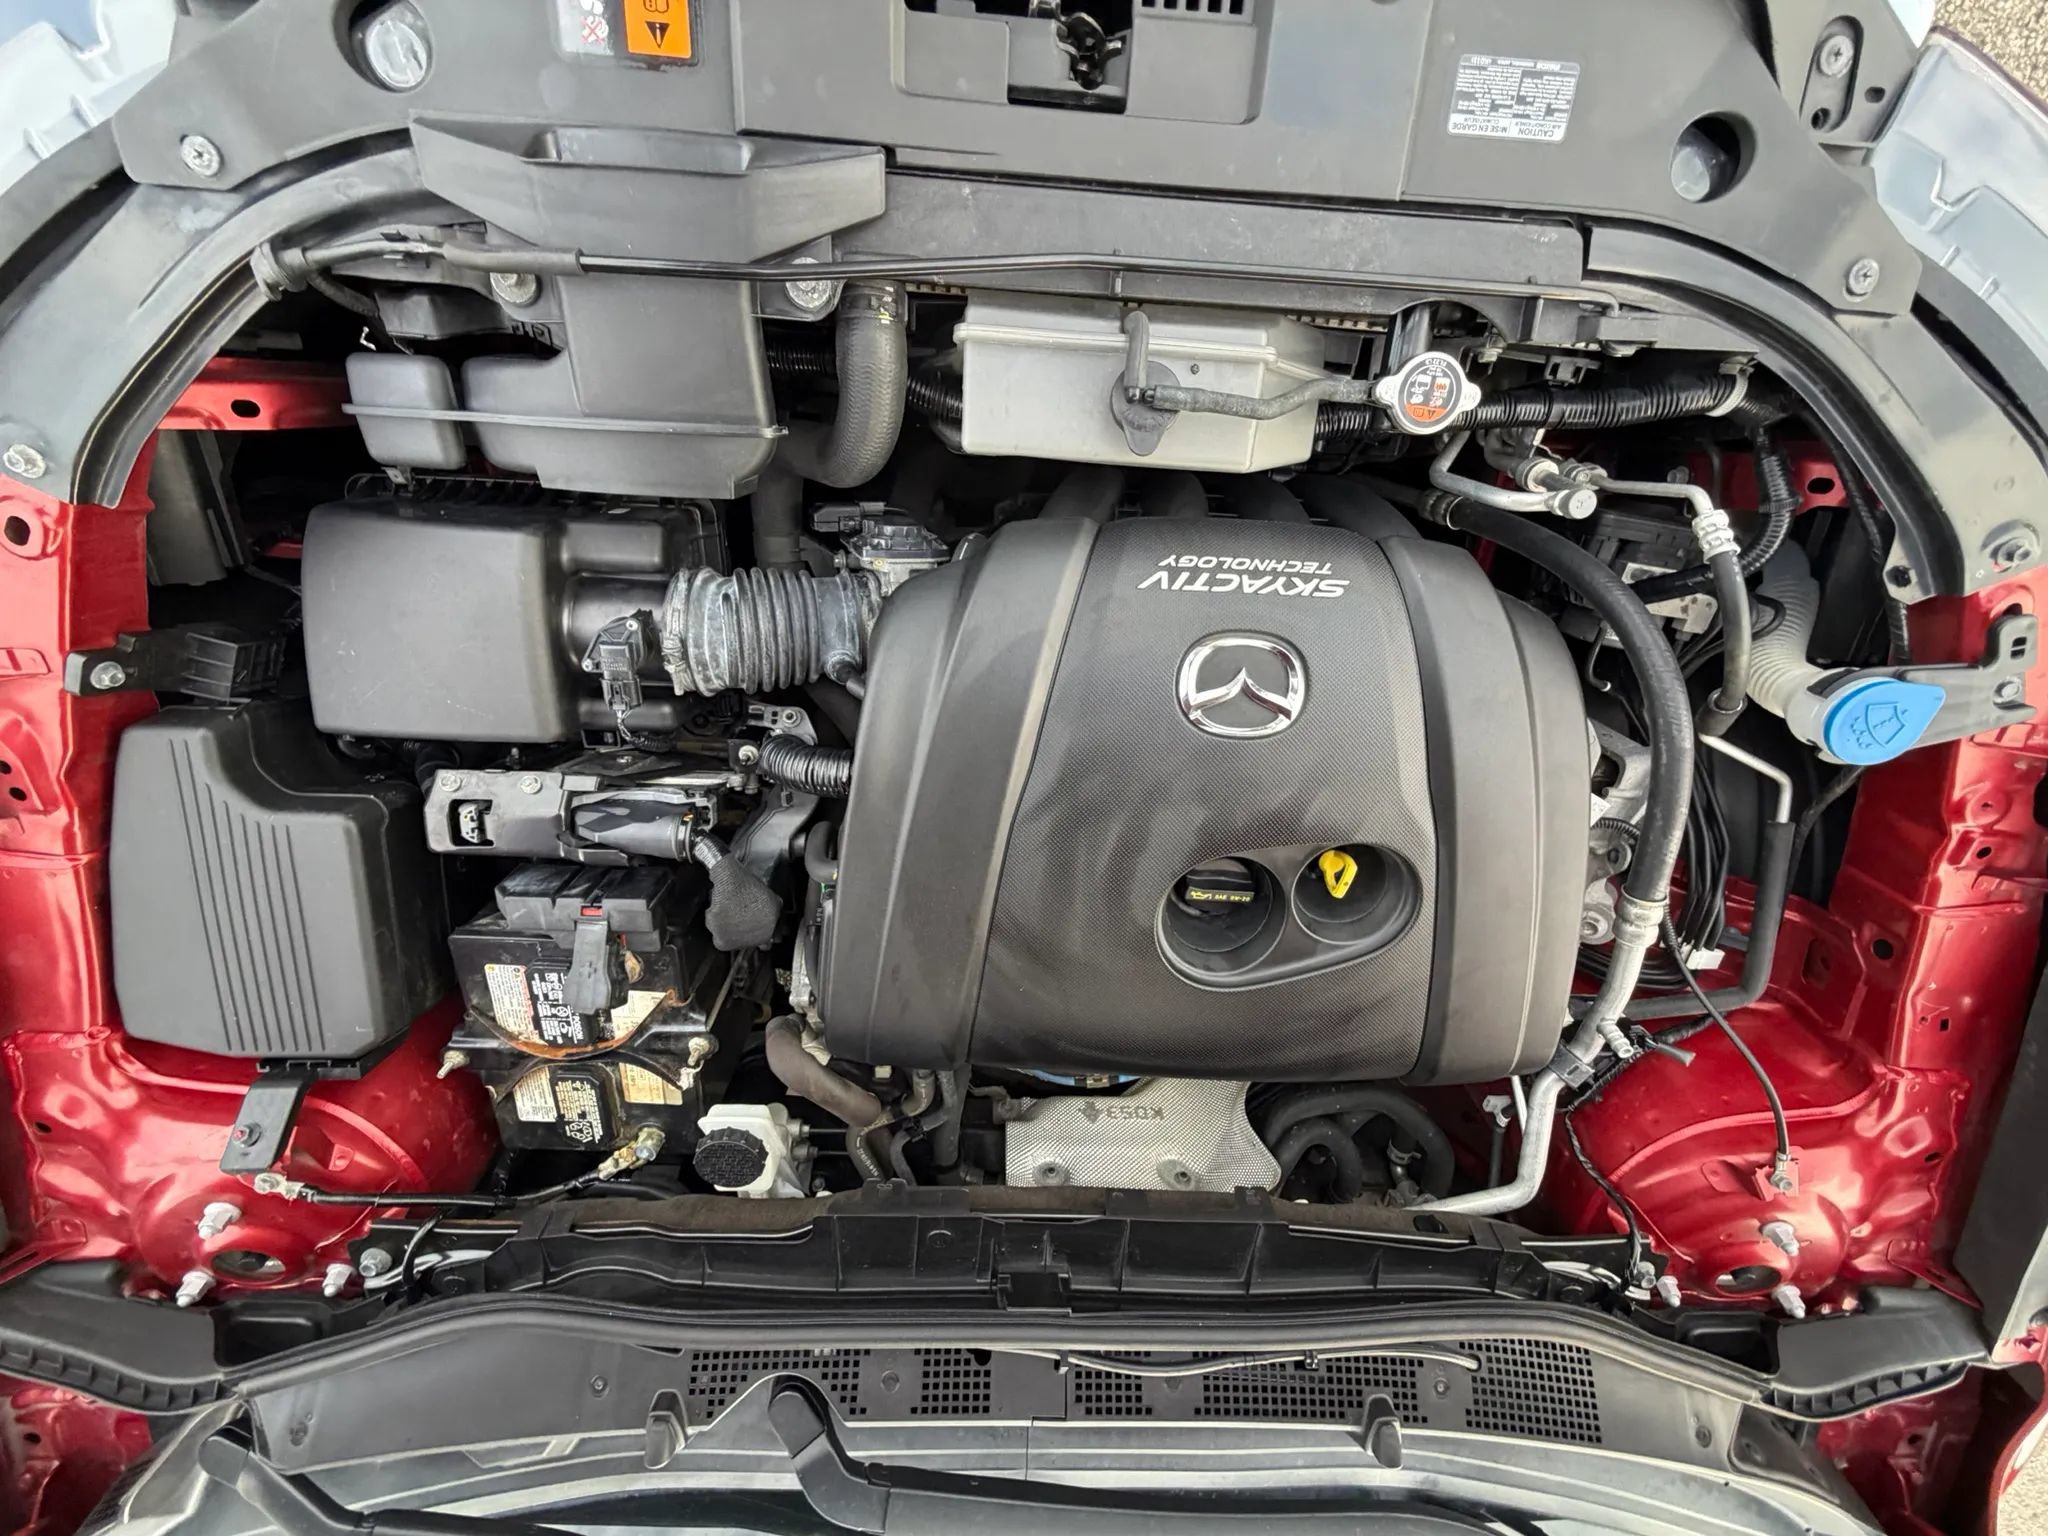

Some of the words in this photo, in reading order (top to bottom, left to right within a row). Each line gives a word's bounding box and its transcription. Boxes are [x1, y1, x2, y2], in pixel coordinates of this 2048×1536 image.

[1452, 122, 1478, 131] GARDE
[1478, 124, 1489, 133] EN
[1491, 125, 1508, 134] MISE
[1518, 128, 1554, 138] CAUTION
[1158, 554, 1333, 575] TECHNOLOGY
[1136, 570, 1350, 599] SKYACTIV
